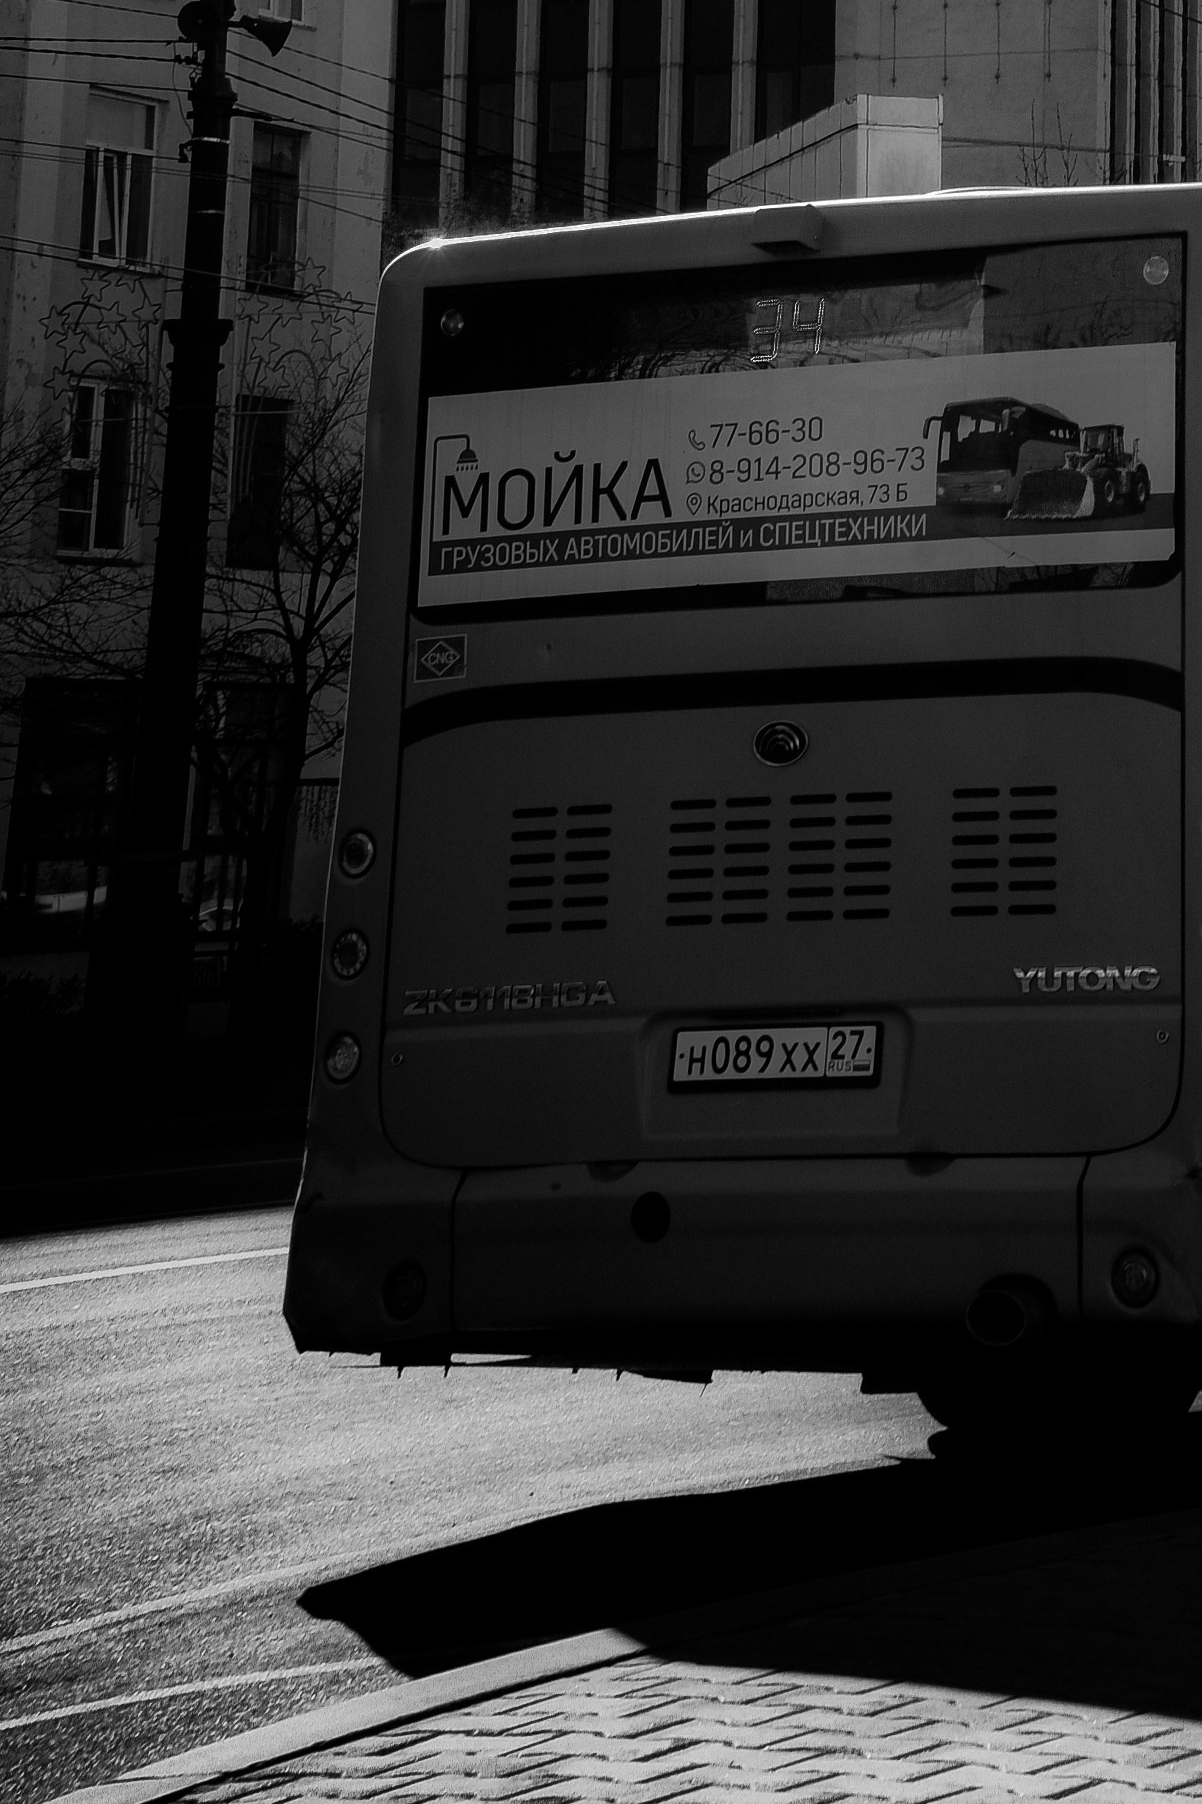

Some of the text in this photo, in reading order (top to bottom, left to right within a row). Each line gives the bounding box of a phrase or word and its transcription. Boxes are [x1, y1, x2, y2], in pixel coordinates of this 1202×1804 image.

[750, 297, 825, 363] 34
[709, 416, 823, 448] 77-66-30
[709, 446, 926, 485] 8-914-208-96-73
[442, 450, 673, 536] МОЙКА
[707, 483, 909, 517] Краснодарская, 73 Б
[440, 537, 560, 571] ГРУЗОВЫХ
[563, 520, 734, 561] АВТОМОБИЛЕЙ
[759, 513, 927, 547] СПЕЦТЕХНИКИ
[427, 651, 454, 666] CNG
[1013, 965, 1161, 994] YUTONG
[403, 979, 617, 1016] ZK6118HGA
[830, 1030, 865, 1060] 27
[828, 1060, 853, 1073] RUS
